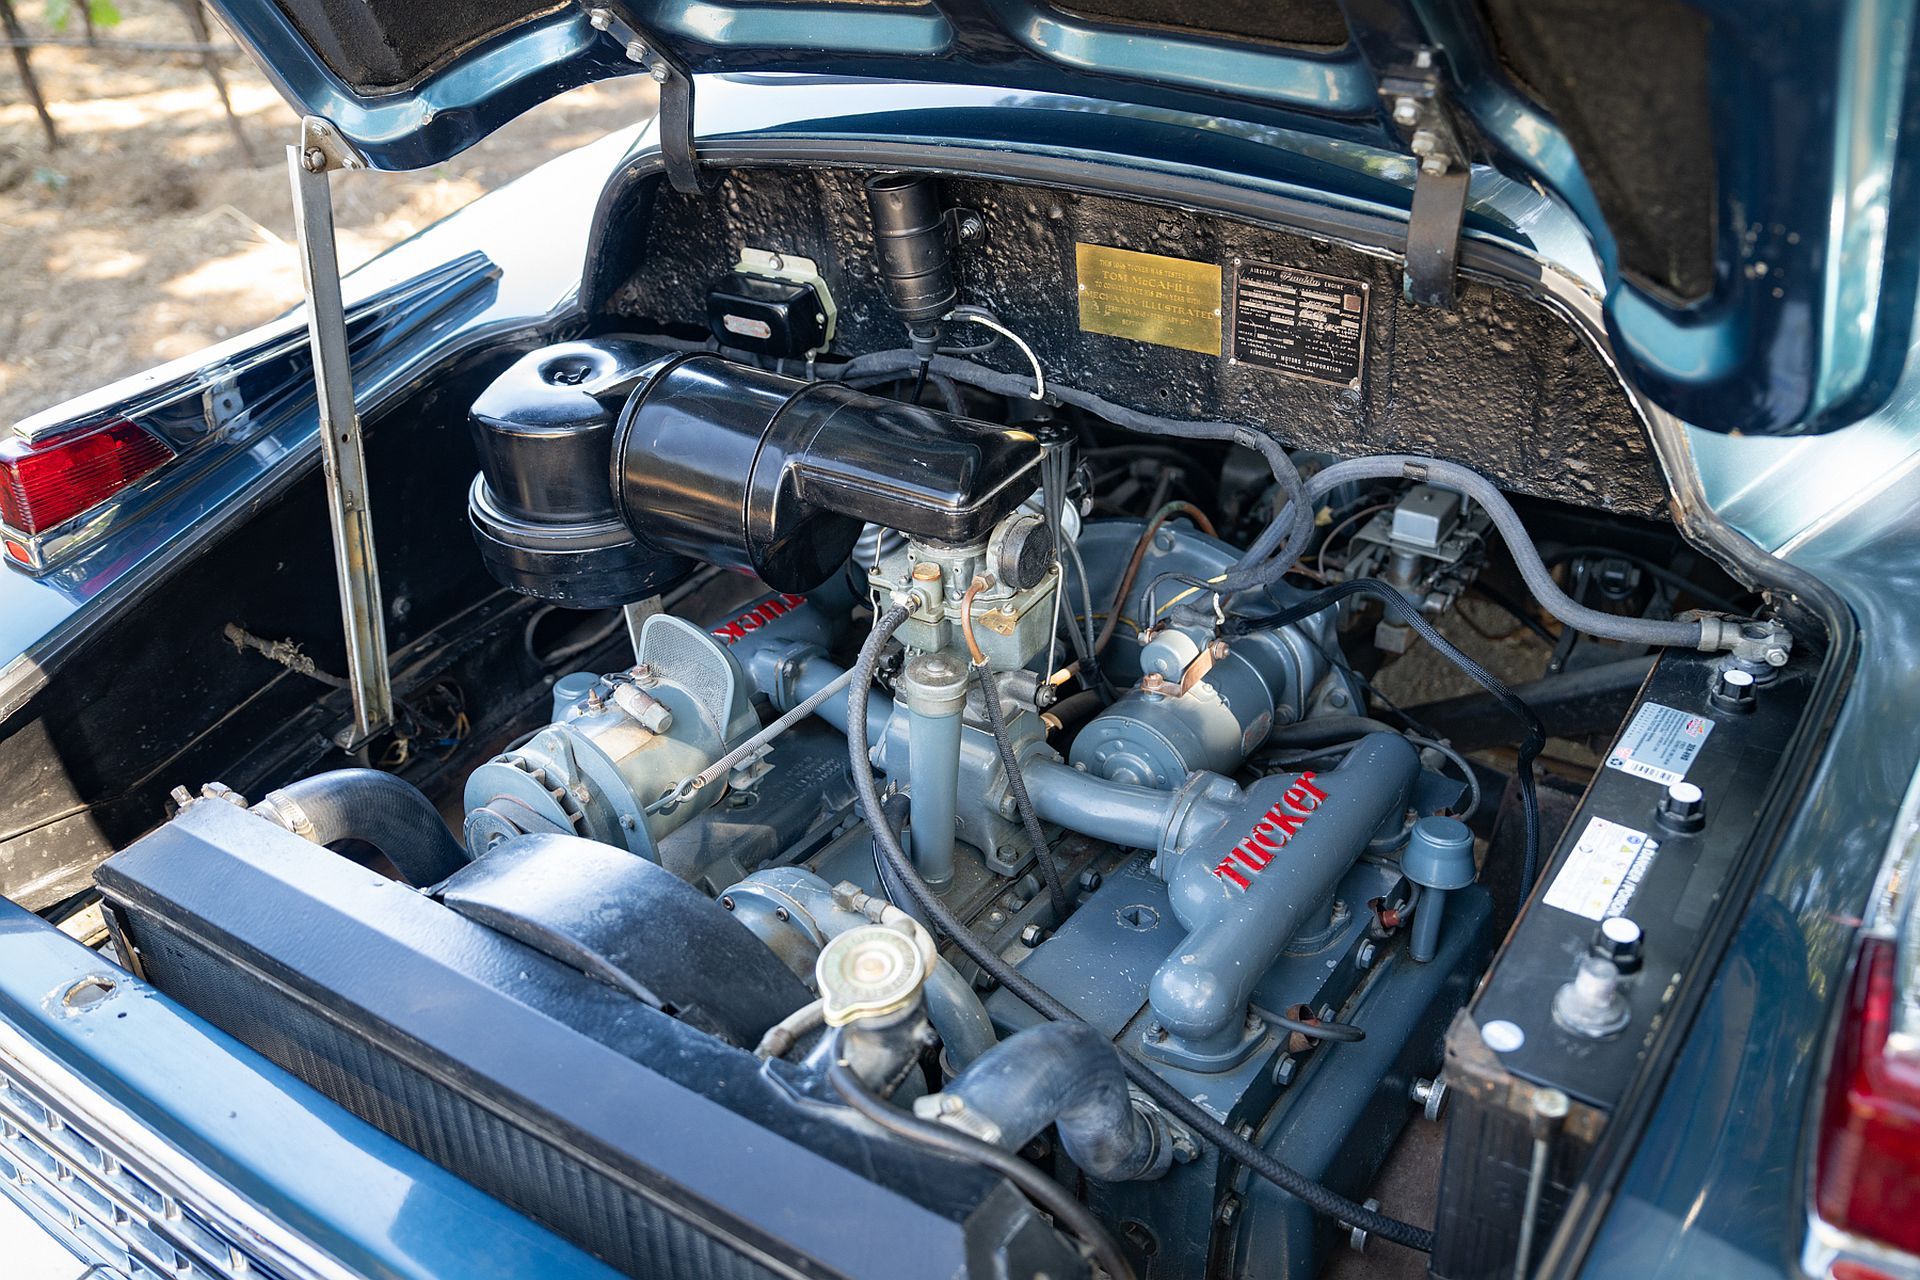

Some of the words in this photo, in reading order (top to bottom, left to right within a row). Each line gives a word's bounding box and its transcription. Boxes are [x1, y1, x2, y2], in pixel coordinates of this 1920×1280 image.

[1102, 270, 1128, 283] TOM
[1250, 267, 1276, 277] AIRCRAFT
[1324, 282, 1344, 291] ENGINE
[1083, 289, 1138, 306] MECHANIX
[1142, 300, 1214, 320] ILLUSTRATED
[1280, 355, 1301, 365] MOTORS
[1306, 360, 1342, 374] CORPORATION
[711, 594, 807, 647] TUCK
